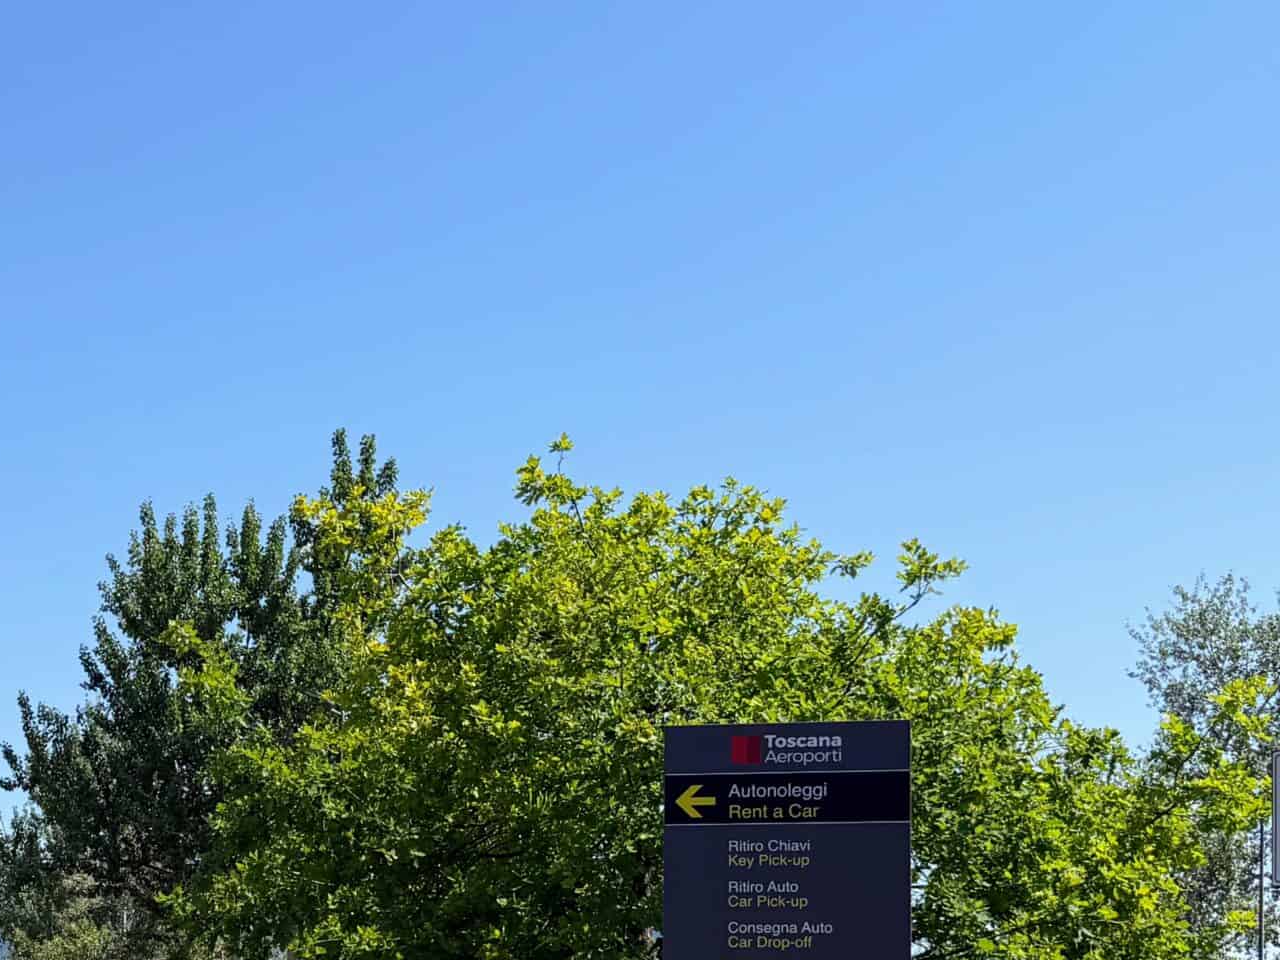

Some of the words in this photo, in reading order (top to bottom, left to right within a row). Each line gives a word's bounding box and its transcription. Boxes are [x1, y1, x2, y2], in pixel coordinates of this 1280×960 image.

[764, 734, 842, 748] Toscana
[764, 749, 842, 765] Aeroporti
[728, 782, 828, 798] Autonoleggi
[729, 805, 768, 818] Rent
[773, 807, 783, 818] a
[789, 803, 820, 818] Car
[728, 840, 763, 852] Ritiro
[767, 840, 810, 851] Chiavi
[728, 855, 754, 869] Key
[759, 854, 810, 868] Pick-up
[728, 881, 763, 893] Ritiro
[767, 881, 799, 893] Auto
[728, 895, 752, 908] Car
[757, 895, 808, 910] Pick-up
[728, 921, 797, 936] Consegna
[801, 922, 833, 934] Auto
[728, 936, 752, 948] Car
[757, 936, 812, 950] Drop-off
